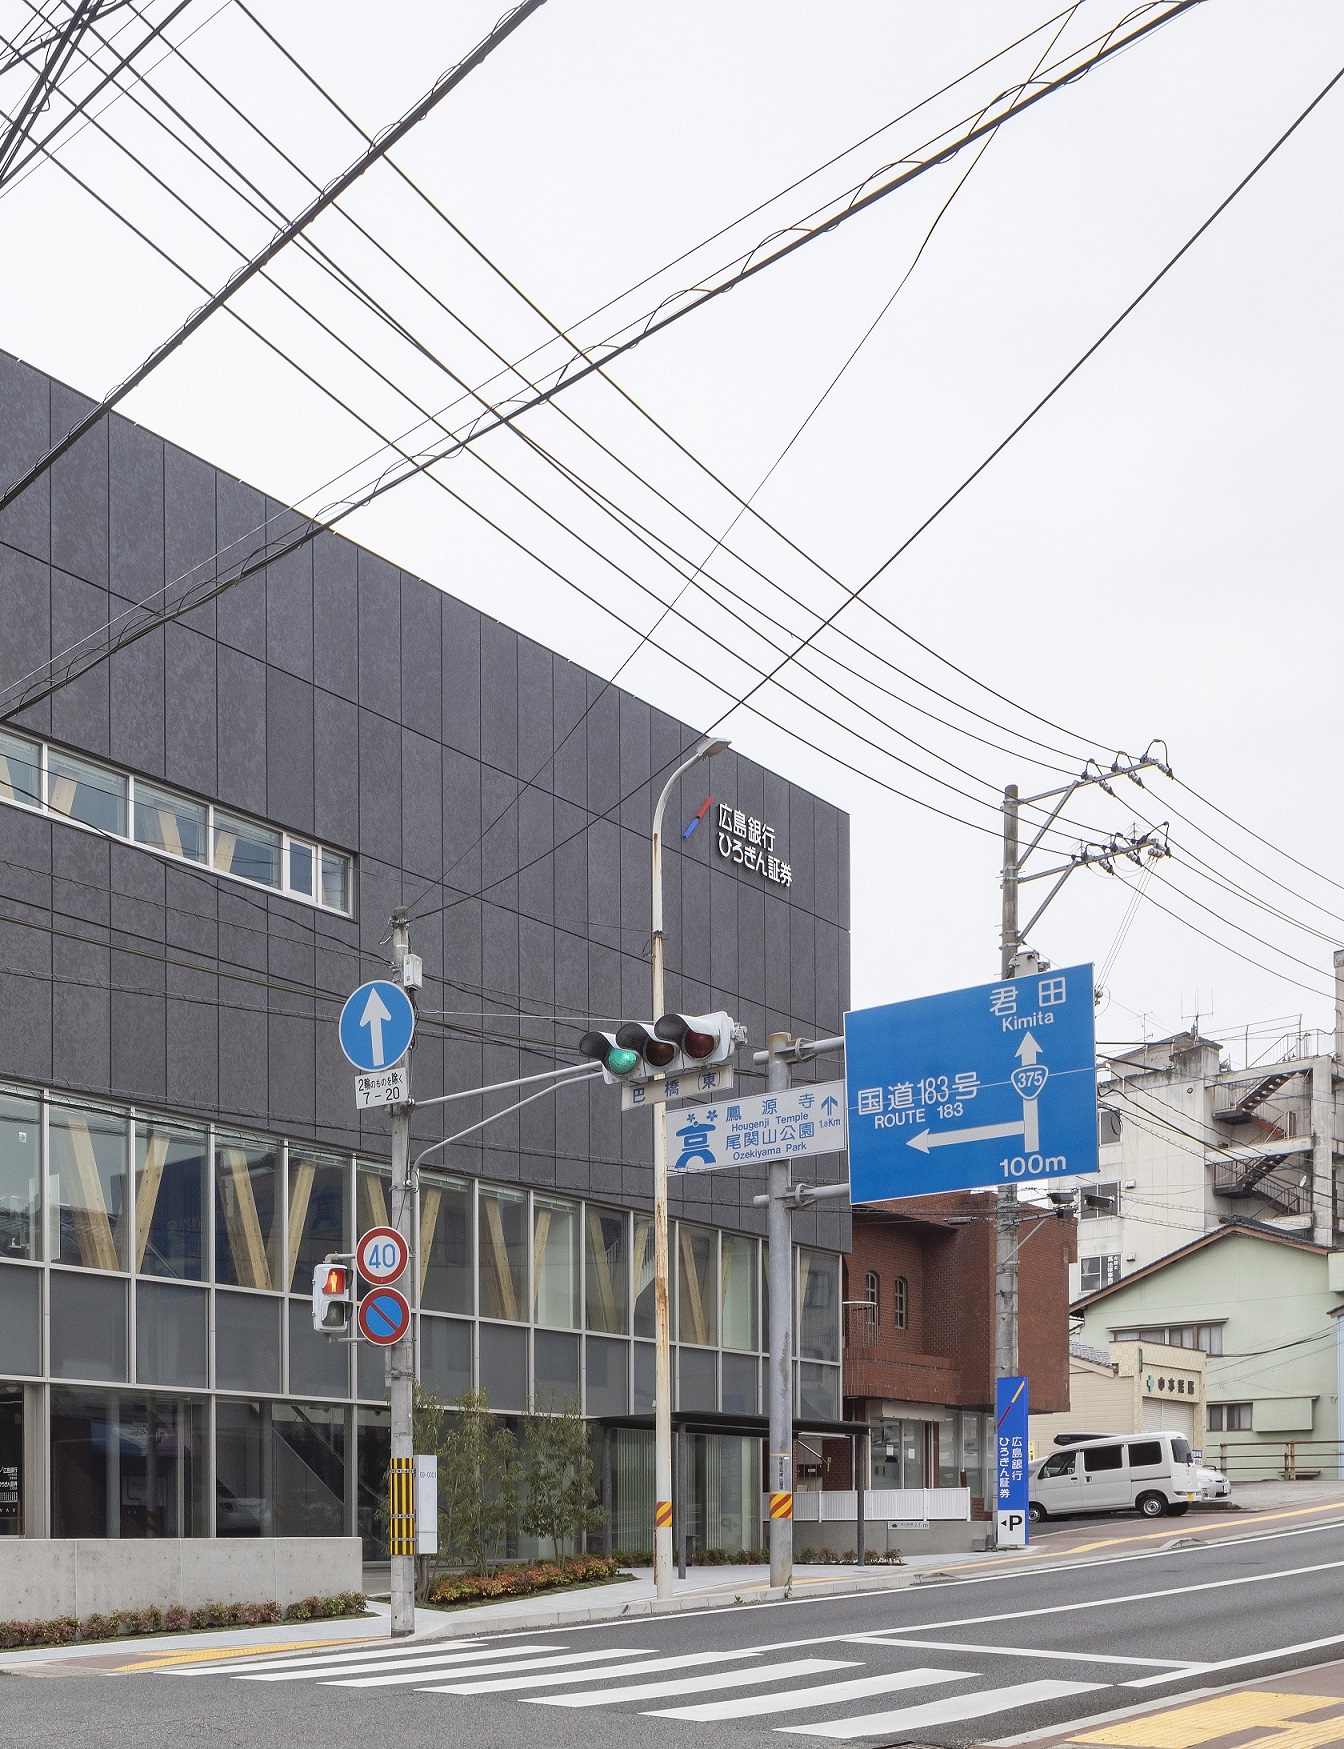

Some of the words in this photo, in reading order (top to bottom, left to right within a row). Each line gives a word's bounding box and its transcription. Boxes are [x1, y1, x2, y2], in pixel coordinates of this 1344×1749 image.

[718, 803, 775, 852] 広島銀行
[718, 831, 792, 887] ひろぎん証券
[1002, 1011, 1054, 1032] Kimita
[1018, 1071, 1043, 1088] 375
[858, 1072, 981, 1116] 国道183号
[731, 1118, 769, 1133] Hougenji
[776, 1112, 809, 1125] Temple
[874, 1109, 926, 1129] ROUTE
[937, 1103, 964, 1119] 183
[725, 1122, 815, 1151] 尾関山公園
[733, 1147, 781, 1161] Ozekiyama
[786, 1142, 807, 1153] Park
[999, 1155, 1067, 1178] 100m
[368, 1243, 396, 1269] 40
[999, 1437, 1010, 1498] ひろぎん証券
[1011, 1436, 1023, 1481] 広島銀行
[1009, 1515, 1023, 1532] P
